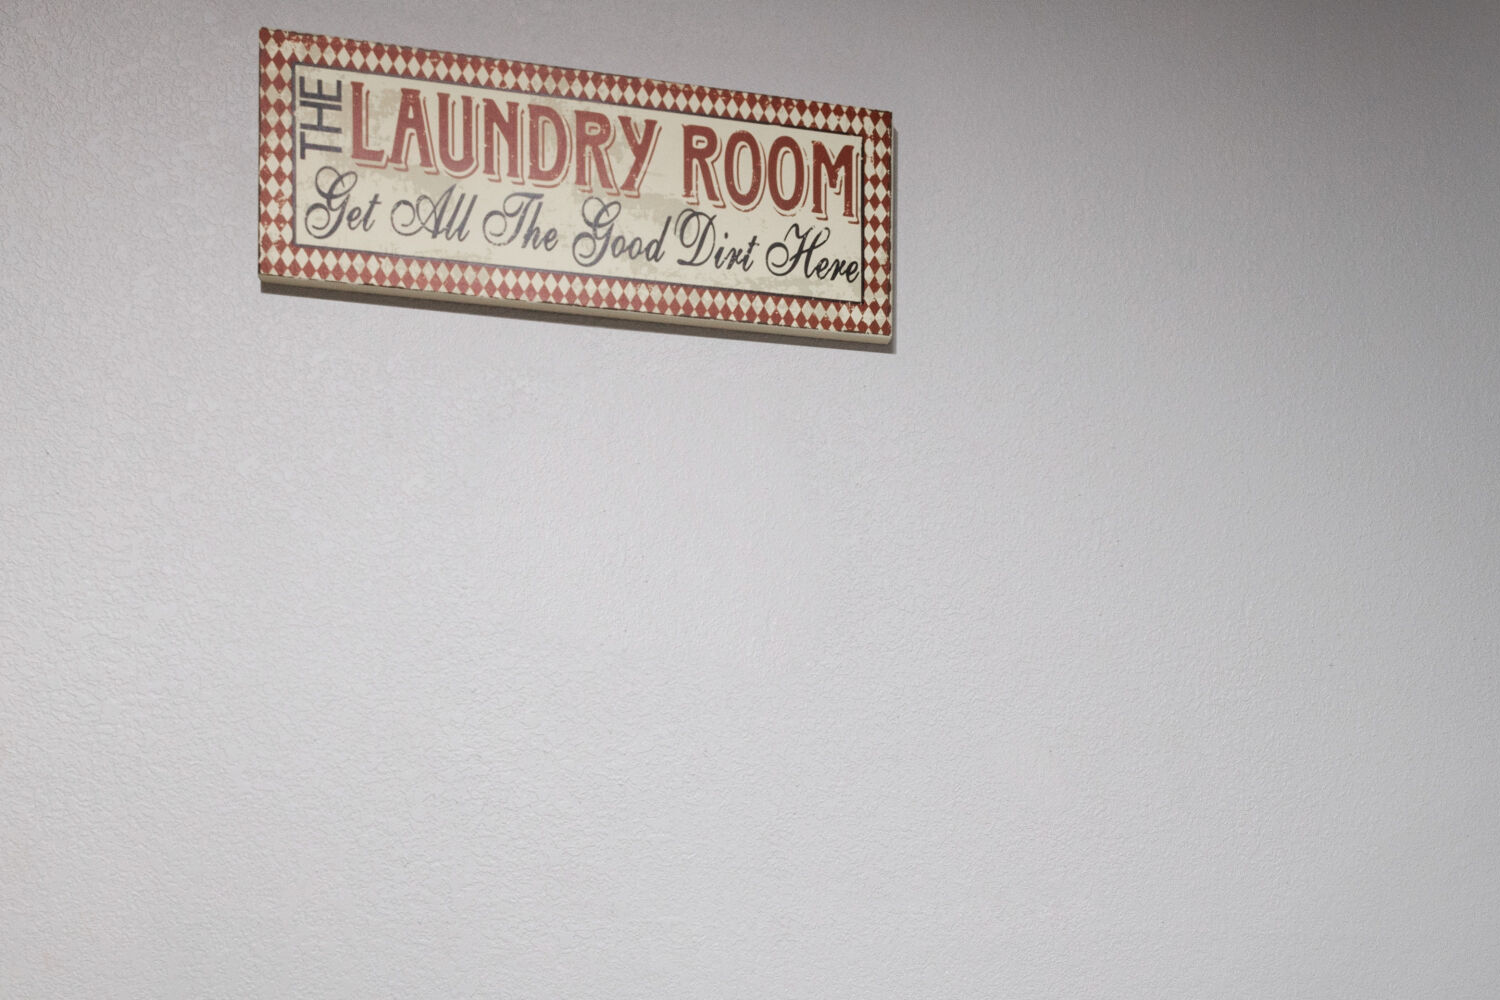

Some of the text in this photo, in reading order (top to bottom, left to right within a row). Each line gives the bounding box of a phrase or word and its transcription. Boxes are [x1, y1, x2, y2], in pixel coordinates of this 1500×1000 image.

[299, 76, 342, 159] THE
[350, 82, 861, 224] LAUNDRY ROOM
[304, 166, 859, 283] Get All The Good Dirt Here
